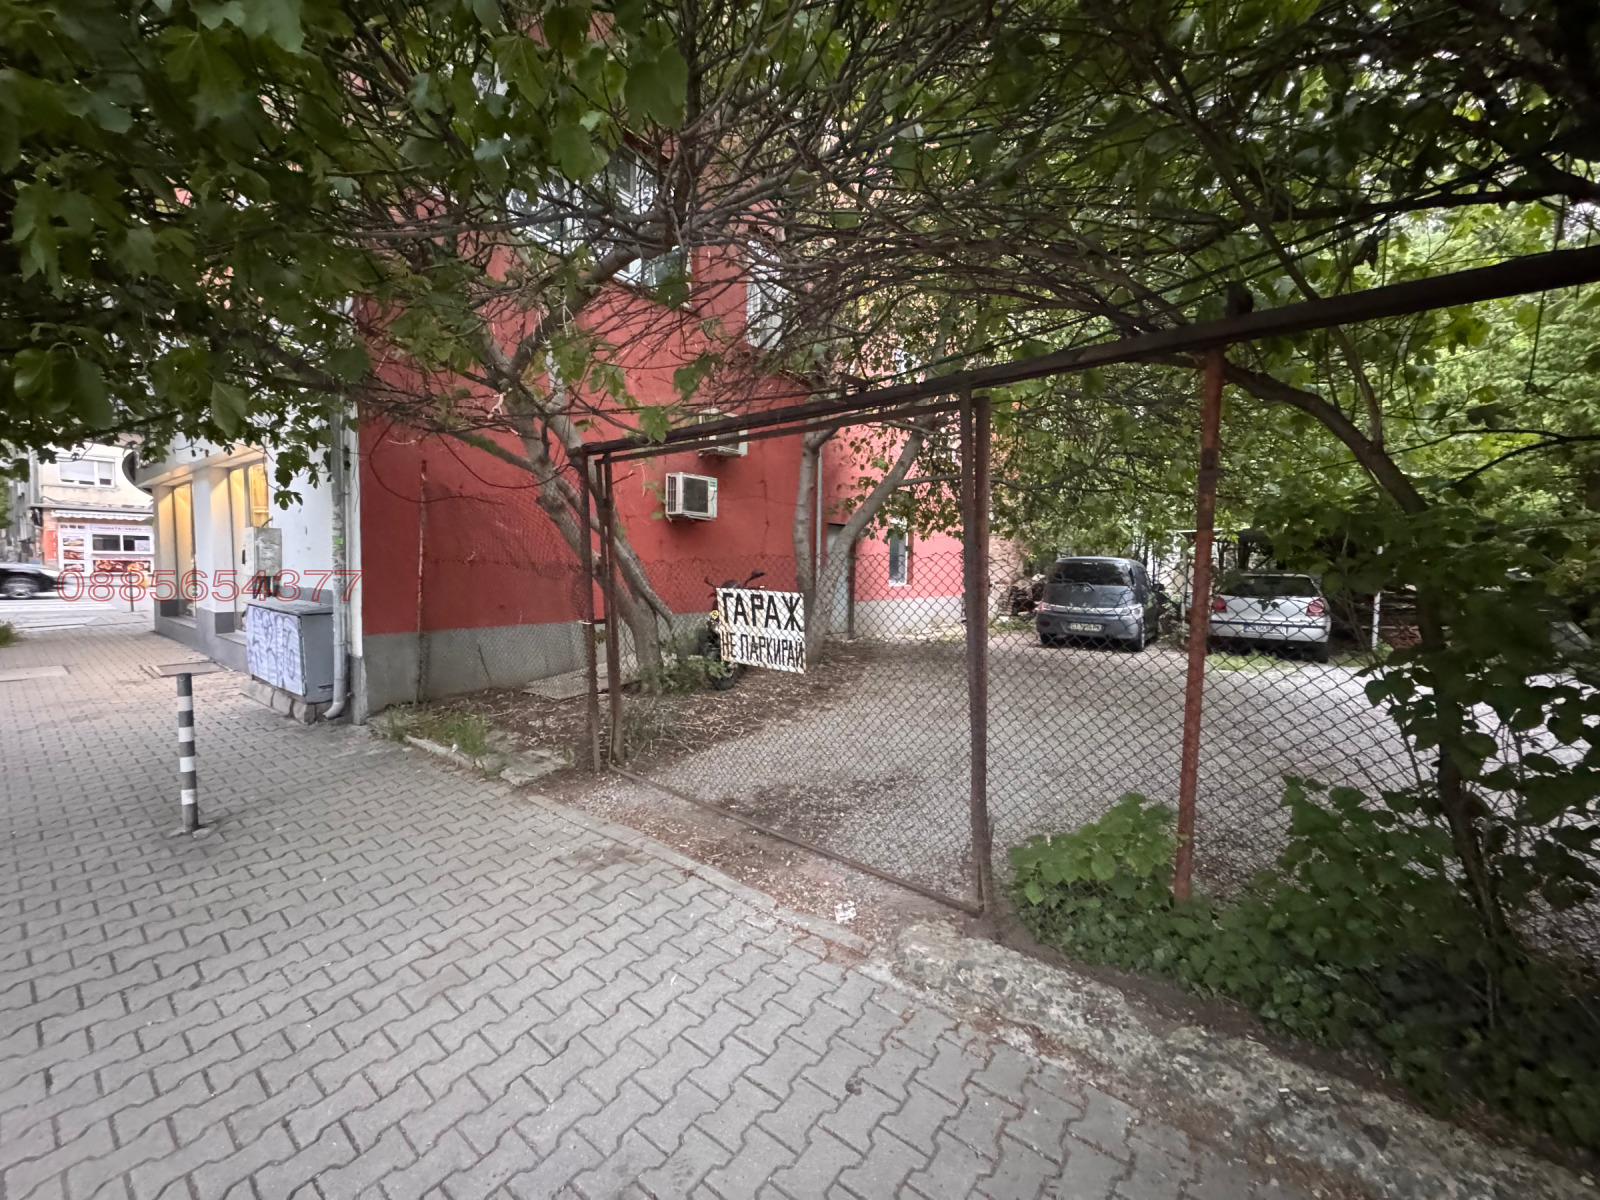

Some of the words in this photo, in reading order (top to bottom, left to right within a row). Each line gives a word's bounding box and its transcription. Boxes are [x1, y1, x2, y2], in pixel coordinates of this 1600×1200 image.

[722, 592, 803, 632] ГАРАЖ
[721, 631, 737, 659] НЕ
[740, 633, 804, 669] ПАРКИРАЙ
